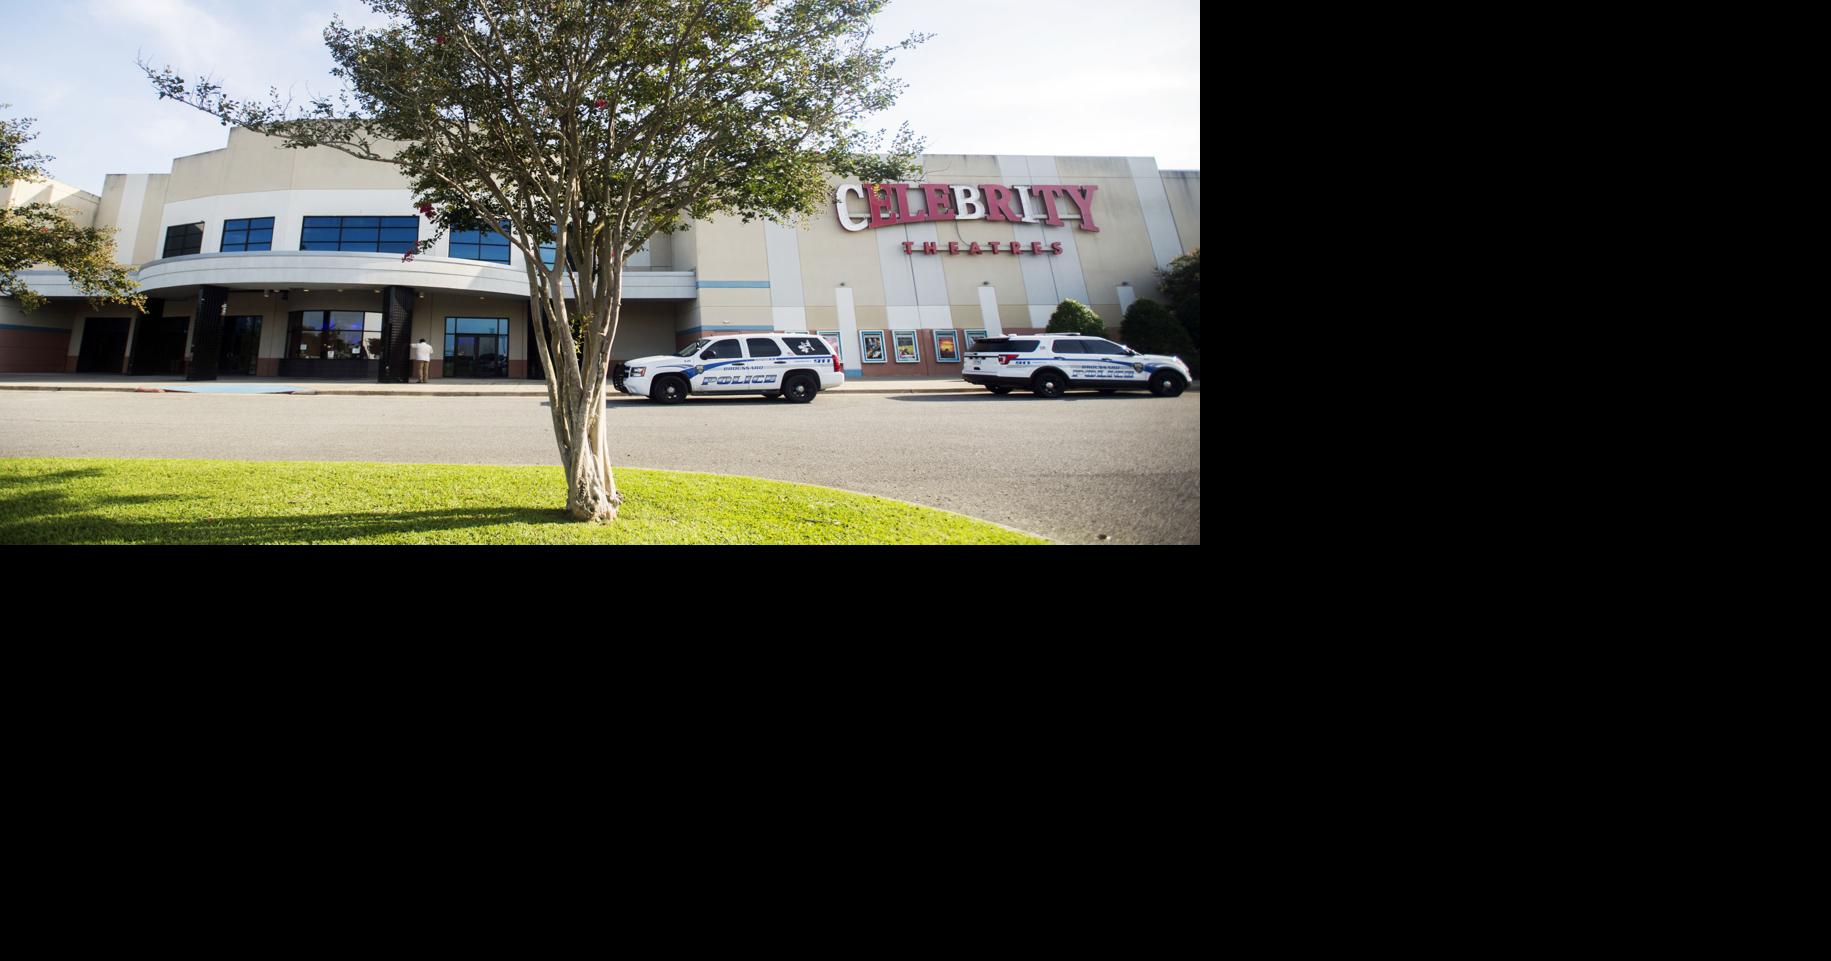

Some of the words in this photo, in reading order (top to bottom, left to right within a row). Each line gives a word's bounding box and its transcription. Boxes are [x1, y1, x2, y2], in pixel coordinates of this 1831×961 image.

[834, 183, 1100, 232] CELEBRITY
[901, 241, 1064, 255] THEATRES
[701, 374, 777, 385] POLICE
